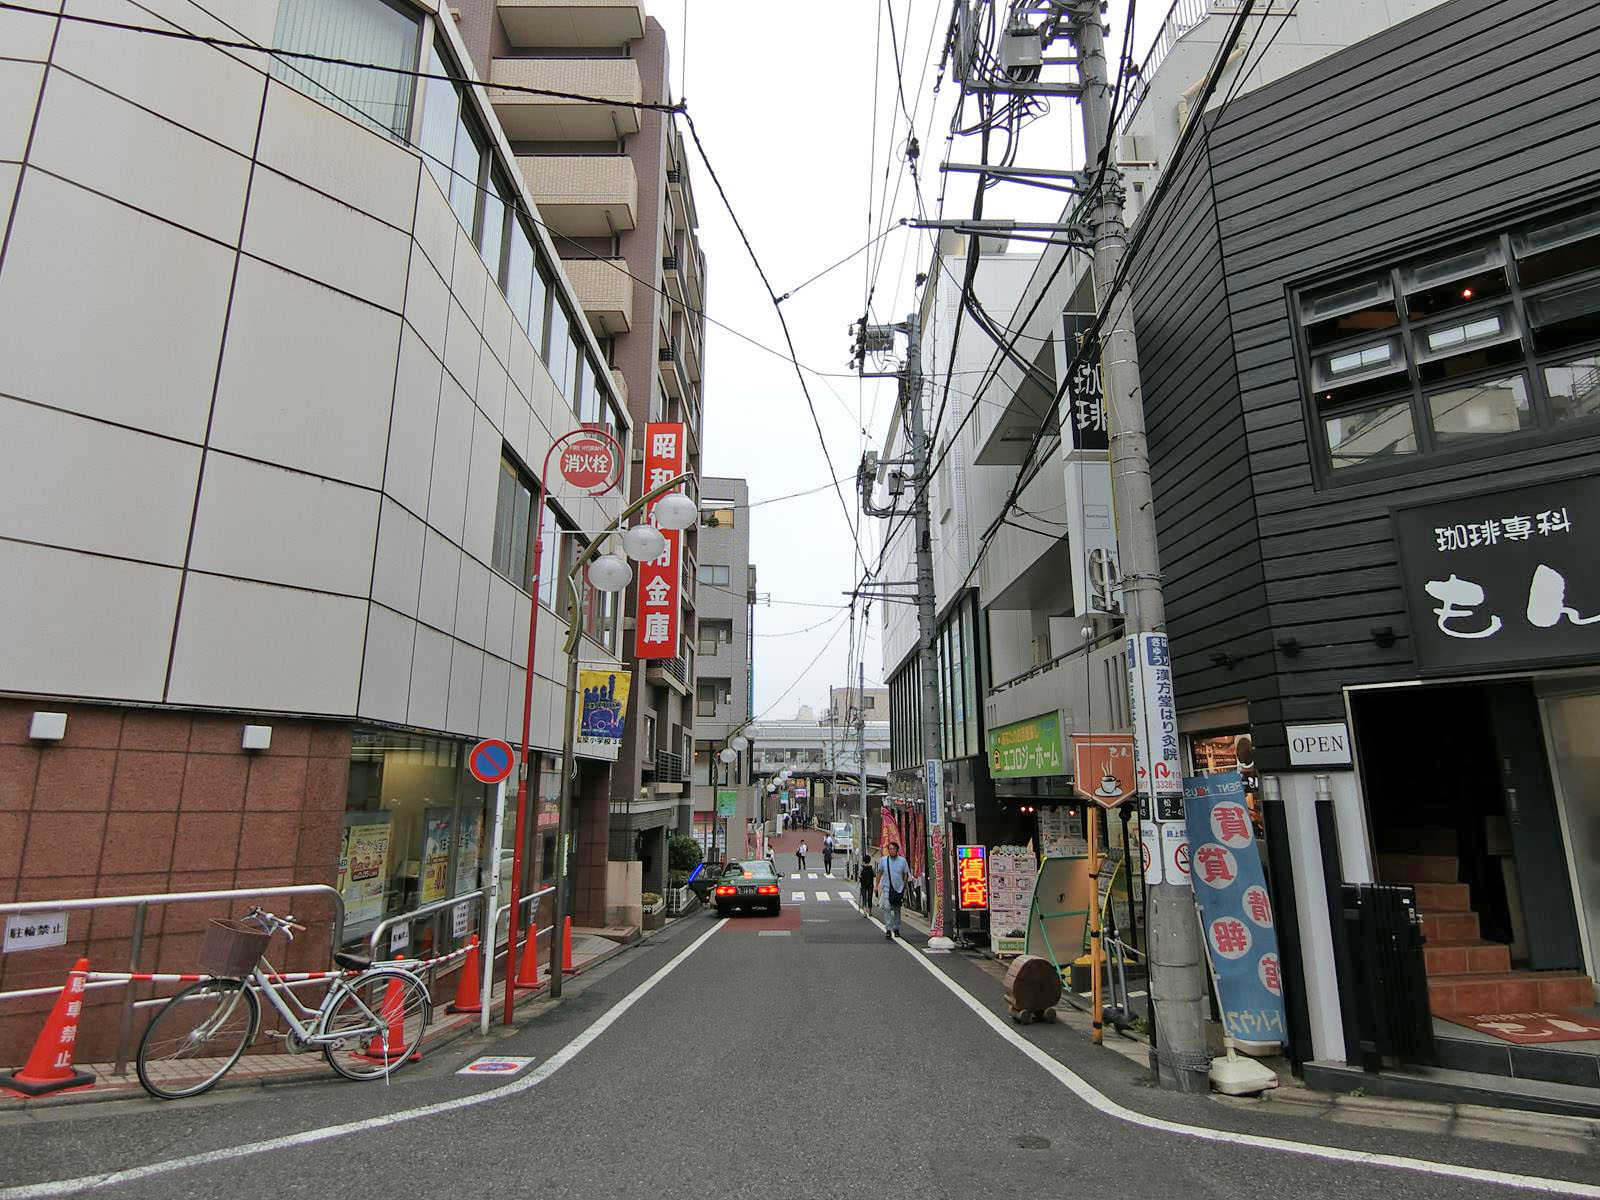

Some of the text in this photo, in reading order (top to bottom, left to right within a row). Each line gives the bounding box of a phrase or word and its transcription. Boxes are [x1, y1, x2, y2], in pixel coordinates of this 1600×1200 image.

[564, 454, 609, 474] 消火栓
[1434, 507, 1572, 552] 珈琲専科
[1156, 668, 1178, 761] 漢方堂はり灸院
[1003, 741, 1060, 771] エコロジーホーム
[1292, 735, 1345, 754] OPEN
[960, 857, 987, 908] 賃貸
[9, 923, 63, 939] 駐輪禁止
[54, 976, 87, 1067] 駐車禁止
